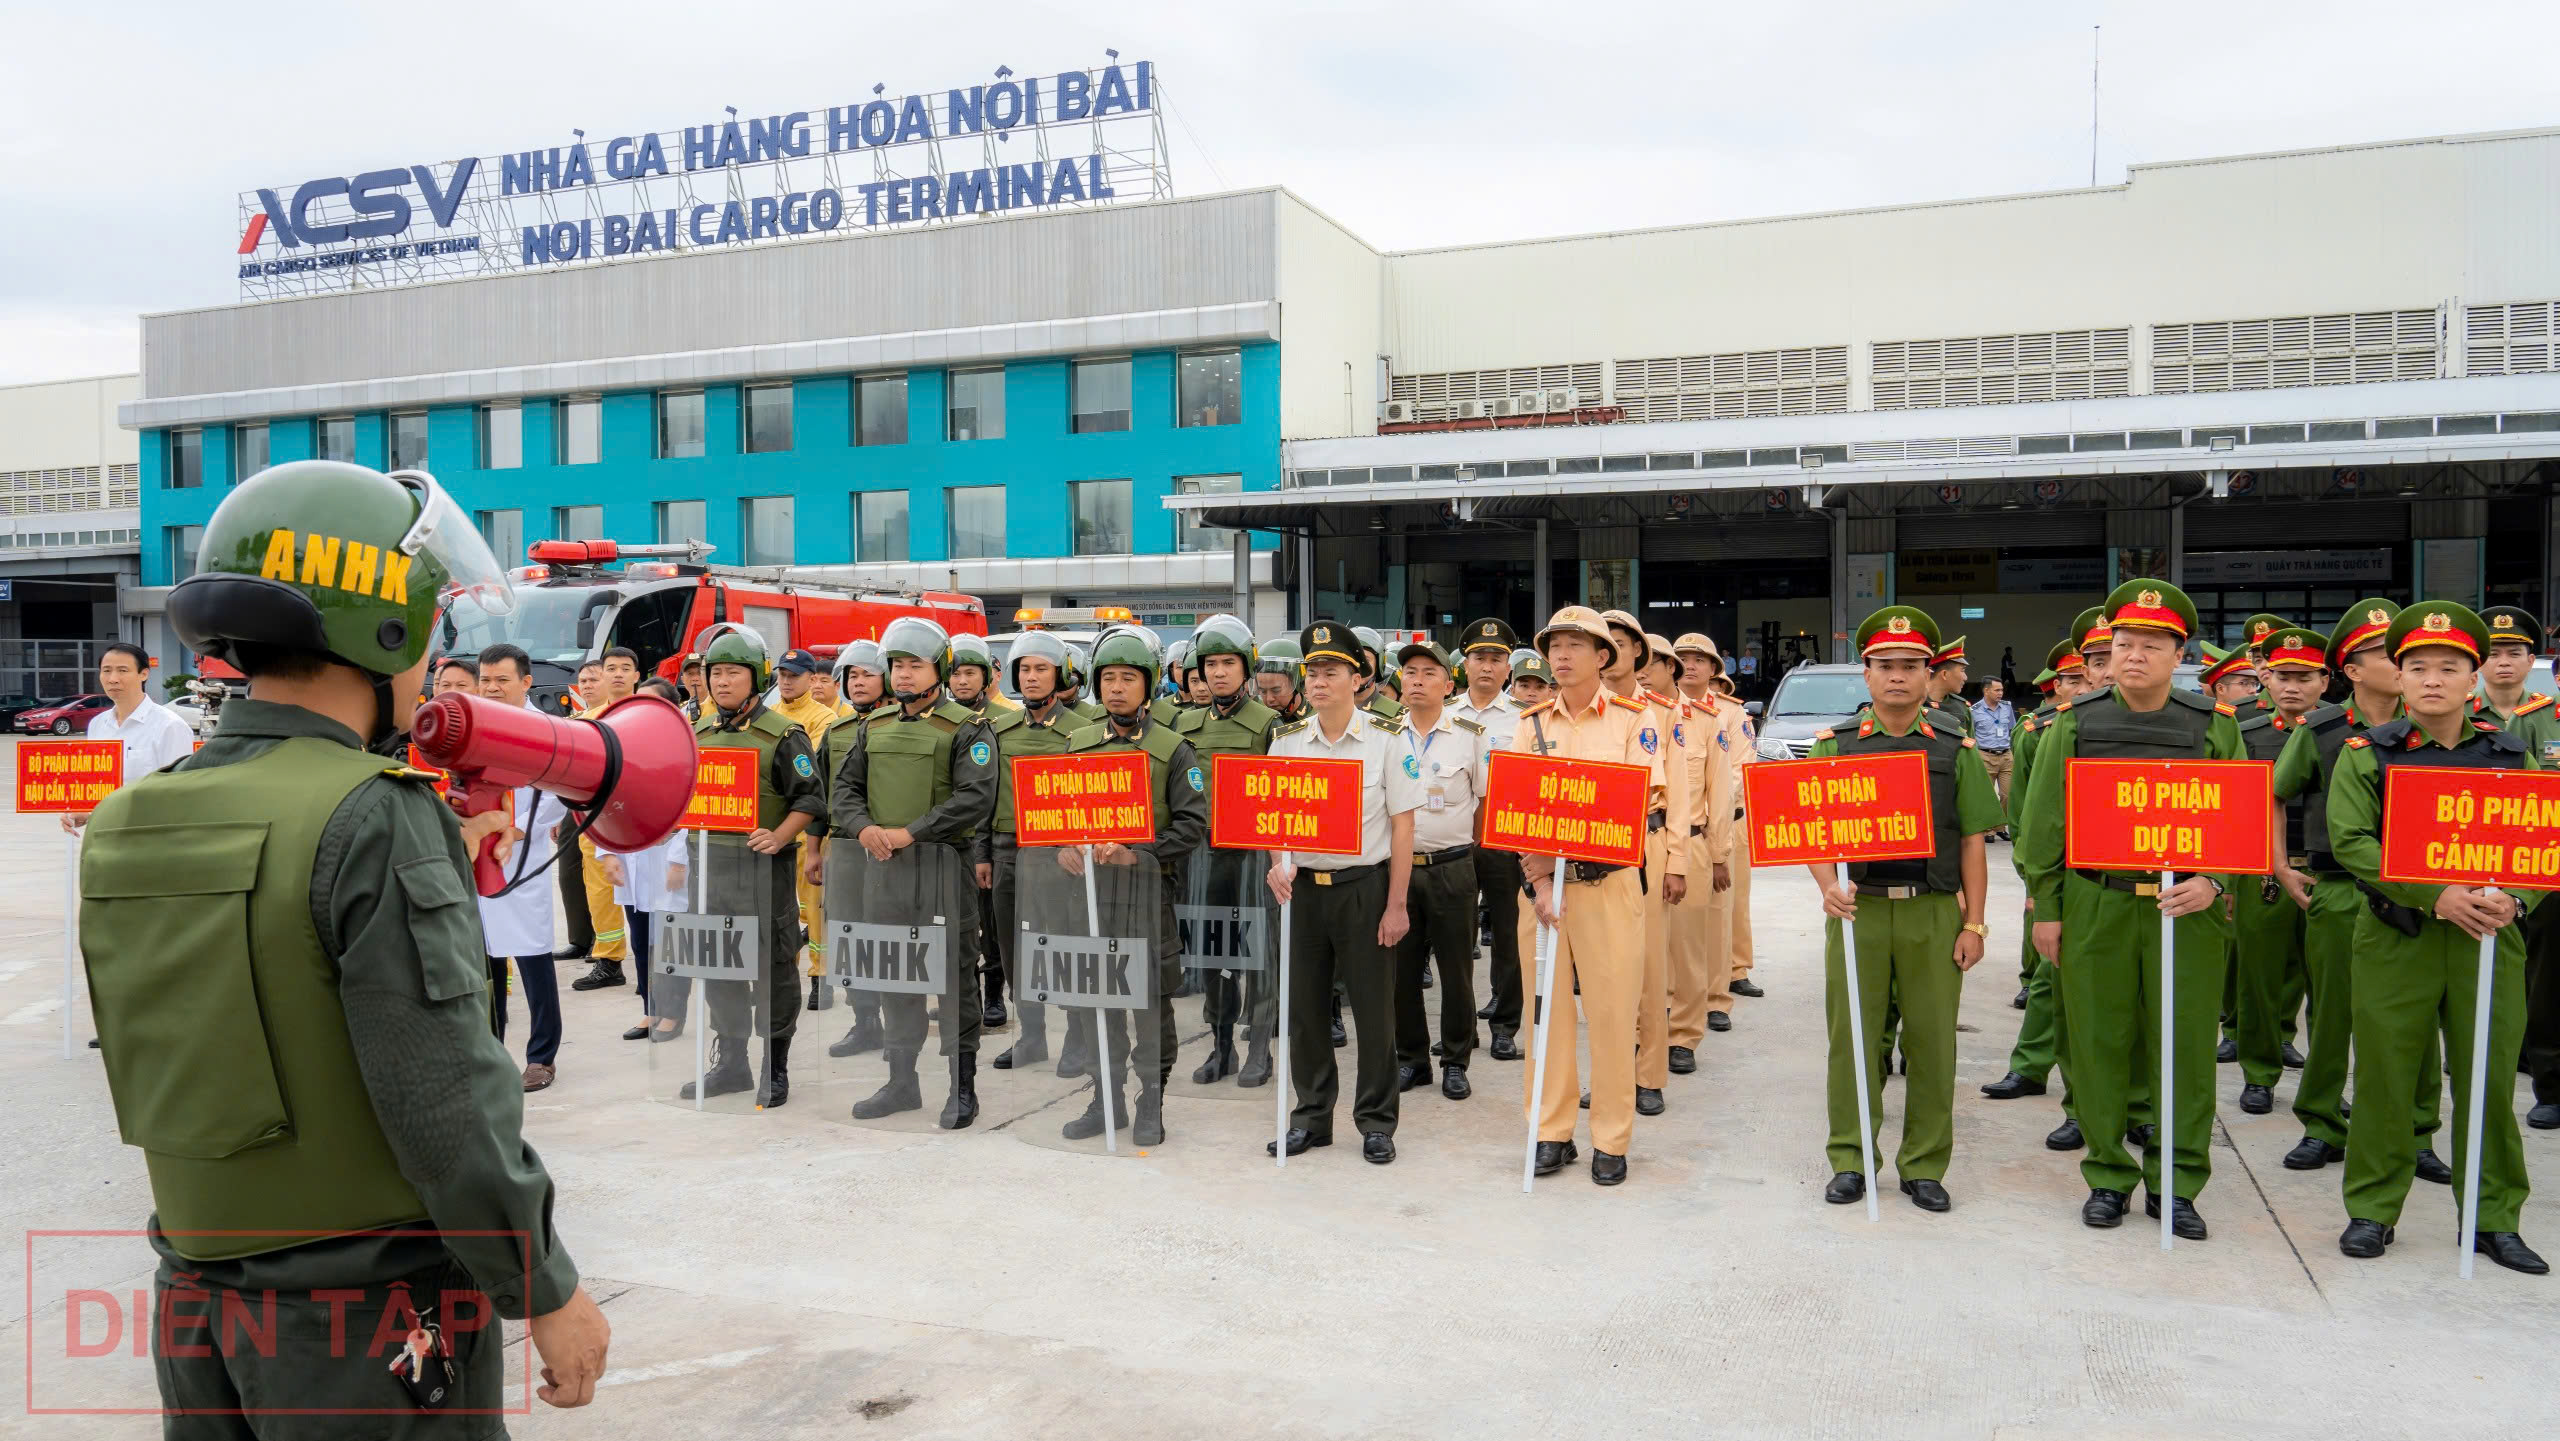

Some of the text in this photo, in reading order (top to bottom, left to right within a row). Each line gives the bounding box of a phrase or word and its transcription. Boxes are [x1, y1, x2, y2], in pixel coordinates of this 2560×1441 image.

[501, 48, 1151, 196] NHÀ GA HÀNG HÓA NỘI BÀI
[238, 157, 479, 254] ACSV
[522, 154, 1115, 266] NOI BAI CARGO TERMINAL
[238, 236, 479, 279] AIR CARGO SERVICES OF VIETNAM
[1673, 495, 1689, 509] 29
[1943, 486, 1959, 500] 31
[260, 528, 413, 606] ANHK
[29, 752, 42, 776] BỘ
[43, 752, 69, 776] PHẬN
[94, 749, 113, 773] BẢO
[1034, 766, 1132, 800] BỘ PHẬN BAO VÂY
[1245, 769, 1329, 804] BỘ PHẬN
[1539, 771, 1597, 808] BỘ PHẬN
[1797, 772, 1877, 811] BỘ PHẬN
[2116, 776, 2222, 814] BỘ PHẬN
[1025, 808, 1064, 832] PHONG
[1093, 807, 1114, 833] LỤC
[1116, 801, 1145, 829] SOÁT
[1256, 809, 1318, 837] SƠ TÁN
[1495, 803, 1632, 849] ĐẢM BẢO GIAO THÔNG
[1765, 810, 1917, 851] BẢO VỆ MỤC TIÊU
[2436, 789, 2560, 833] BỘ PHẬN
[2134, 823, 2202, 860] DỰ BỊ
[2425, 832, 2504, 873] CẢNH
[661, 926, 745, 968] ANHK
[1179, 918, 1252, 958] NHK
[835, 936, 930, 982] ANHK
[1030, 949, 1132, 996] ANHK
